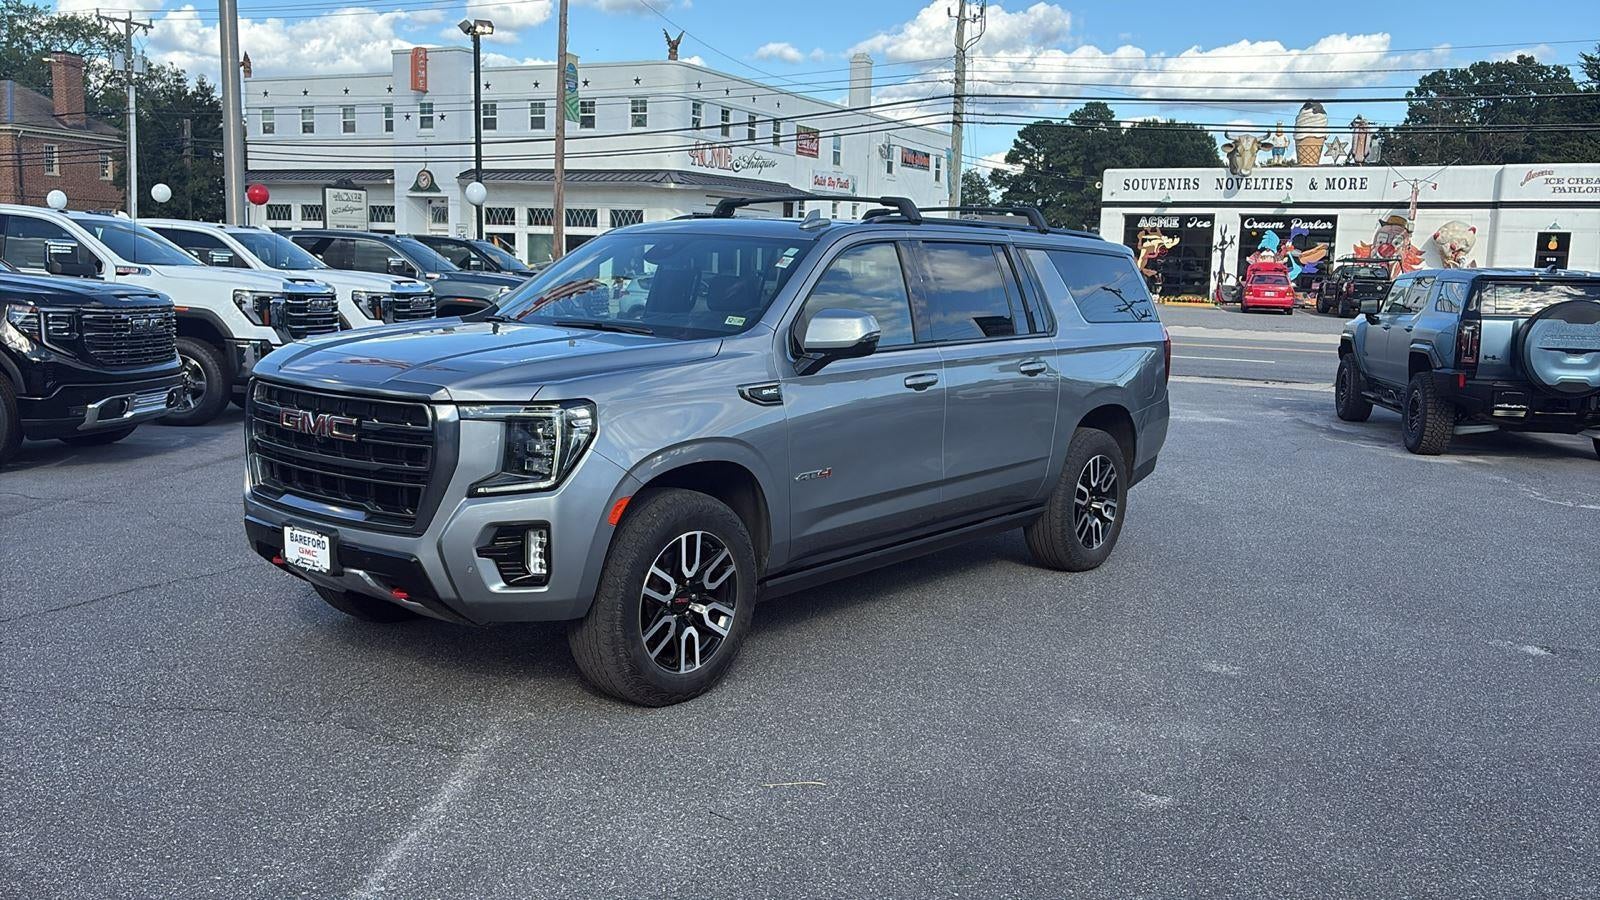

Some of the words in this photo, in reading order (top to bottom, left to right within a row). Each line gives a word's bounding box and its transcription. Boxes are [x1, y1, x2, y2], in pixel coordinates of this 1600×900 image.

[688, 140, 733, 171] ACME
[1123, 178, 1200, 191] SOUVENIRS
[1215, 177, 1293, 190] NOVELTIES
[1308, 177, 1318, 191] &
[1325, 177, 1368, 190] MORE
[1544, 177, 1565, 185] ICE
[1552, 186, 1600, 194] PARLOR
[1137, 216, 1180, 228] ACME
[1187, 217, 1212, 228] Ice
[1244, 217, 1285, 229] Cream
[1290, 218, 1334, 229] Parlor
[280, 407, 357, 442] GMC
[794, 467, 832, 481] AT4
[290, 532, 326, 550] BAREFORD
[299, 546, 318, 558] GMC
